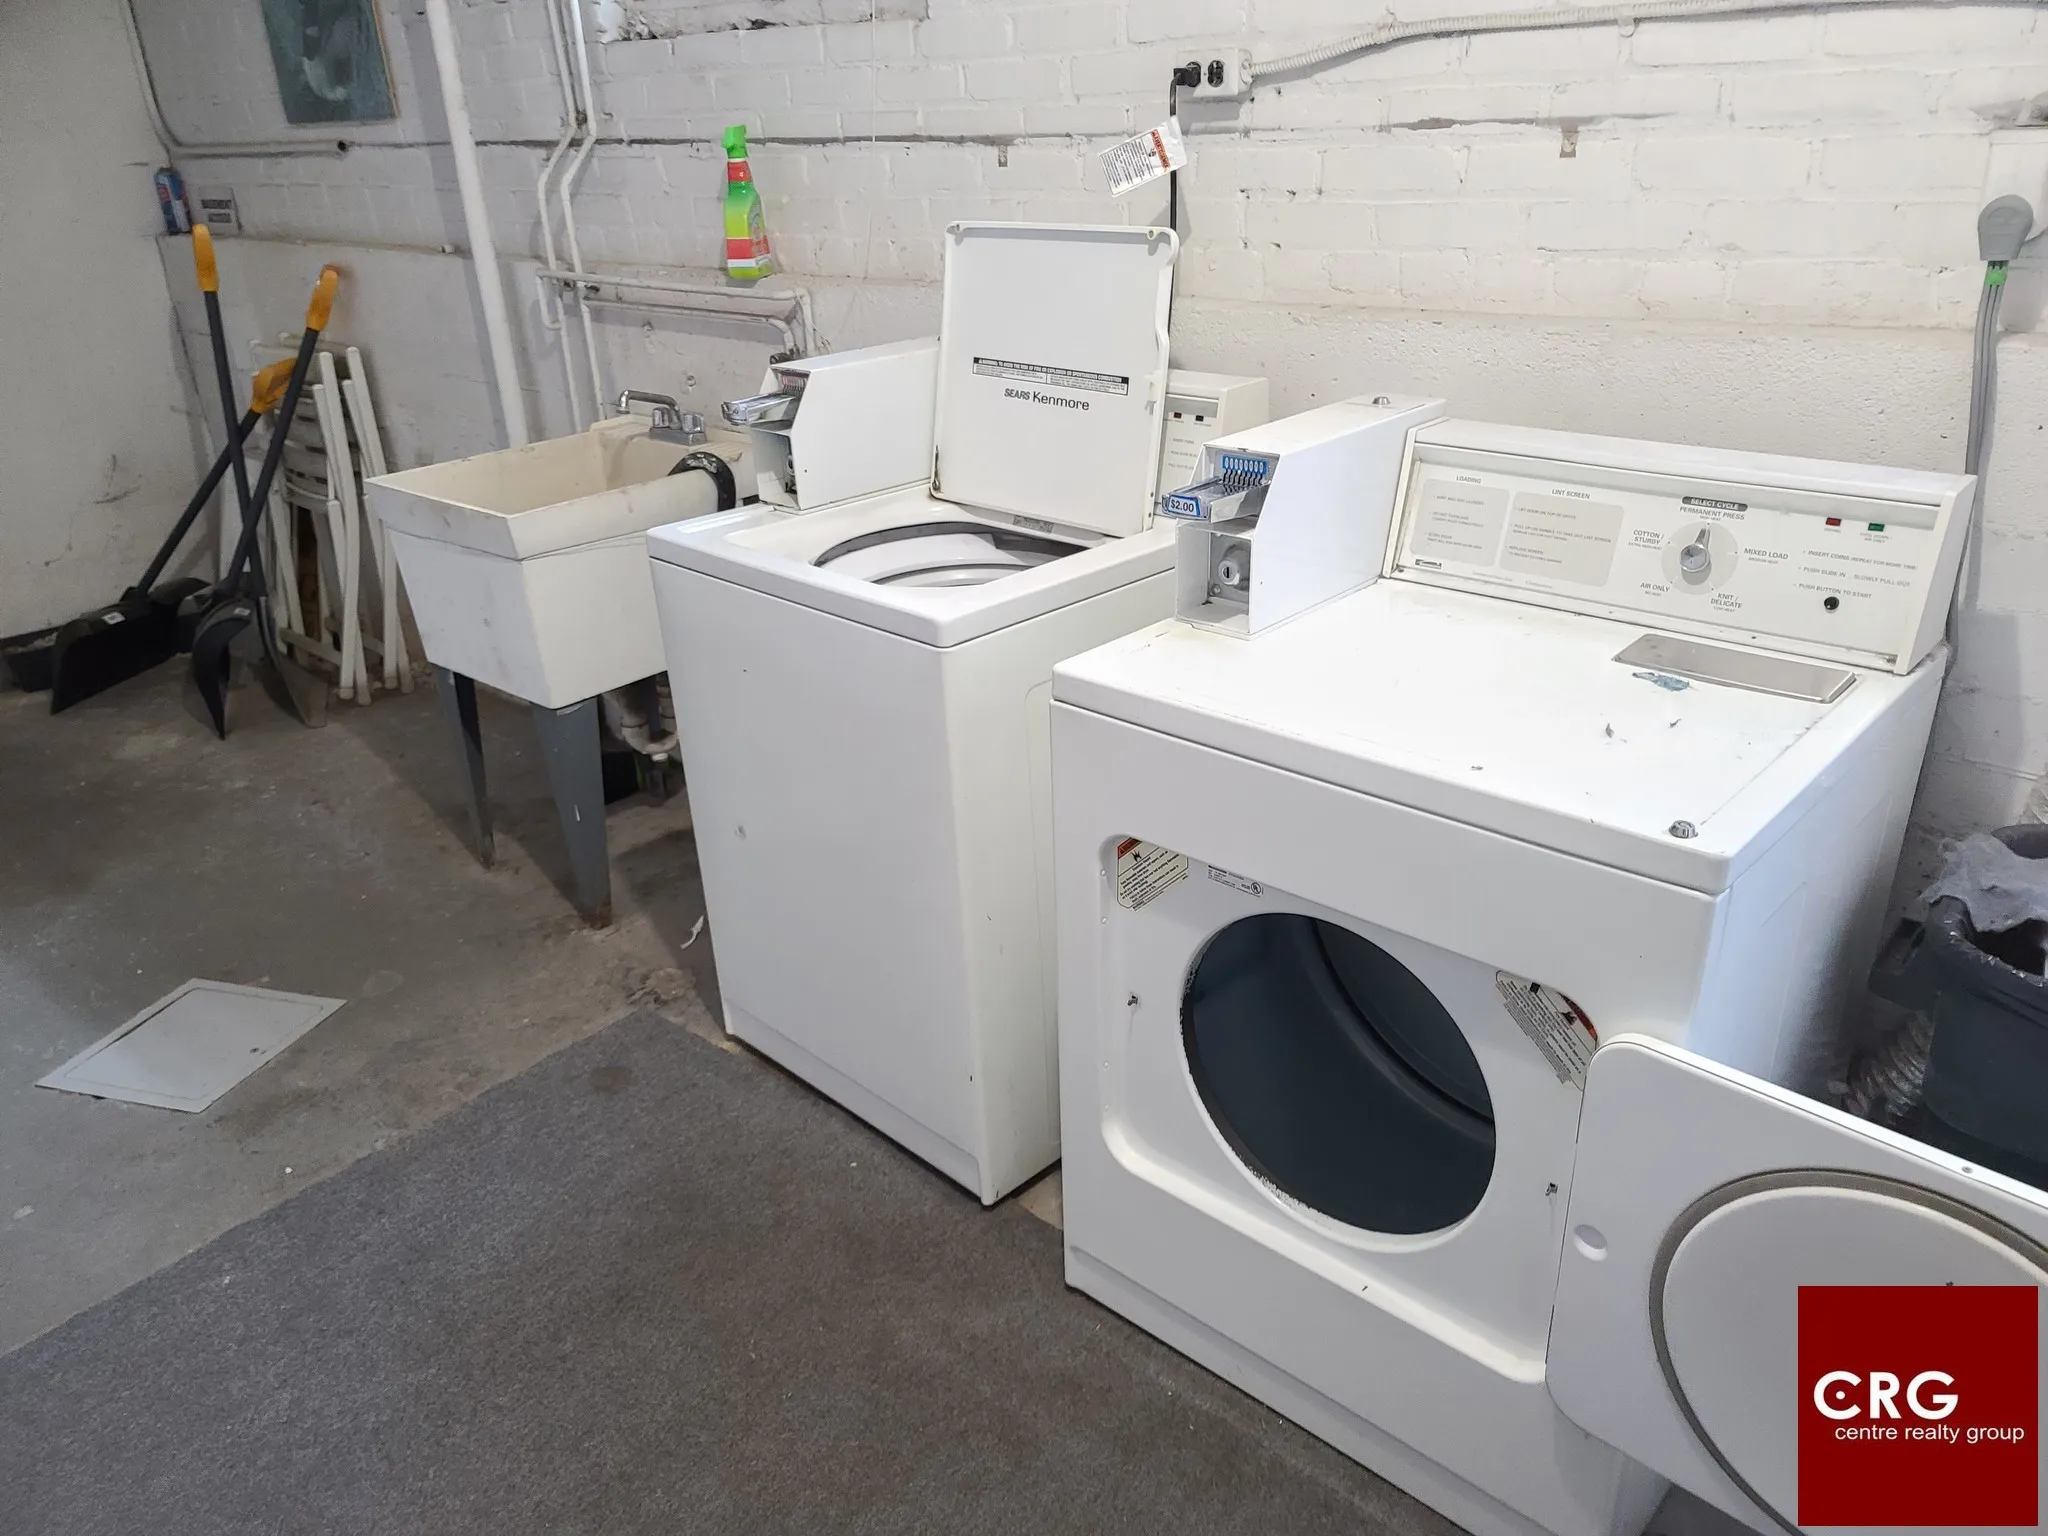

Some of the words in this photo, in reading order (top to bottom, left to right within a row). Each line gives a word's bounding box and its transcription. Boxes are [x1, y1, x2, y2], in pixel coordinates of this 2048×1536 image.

[1004, 388, 1030, 400] SEARS
[1033, 391, 1090, 411] Kenmore
[1456, 475, 1481, 484] LOADING
[1566, 491, 1590, 499] SCREEN
[1171, 501, 1194, 513] $2.00
[1690, 498, 1716, 508] SELECT
[1717, 501, 1739, 510] CYCLE
[1680, 506, 1721, 518] PERMANENT
[1722, 512, 1745, 520] PRESS
[1633, 529, 1661, 539] COTTON
[1634, 536, 1661, 545] STURDY
[1744, 547, 1767, 557] MIXED
[1768, 551, 1788, 560] LOAD
[1808, 550, 1829, 558] INSERT
[1831, 553, 1850, 561] COINS
[1803, 566, 1820, 574] PUSH
[1853, 574, 1879, 583] SLOWLY
[1880, 578, 1894, 586] PULL
[1652, 583, 1670, 593] ONLY
[1799, 583, 1815, 591] PUSH
[1816, 586, 1841, 595] BUTTON
[1852, 591, 1872, 599] START
[1718, 592, 1734, 601] KNIT
[1711, 598, 1742, 609] DELICATE
